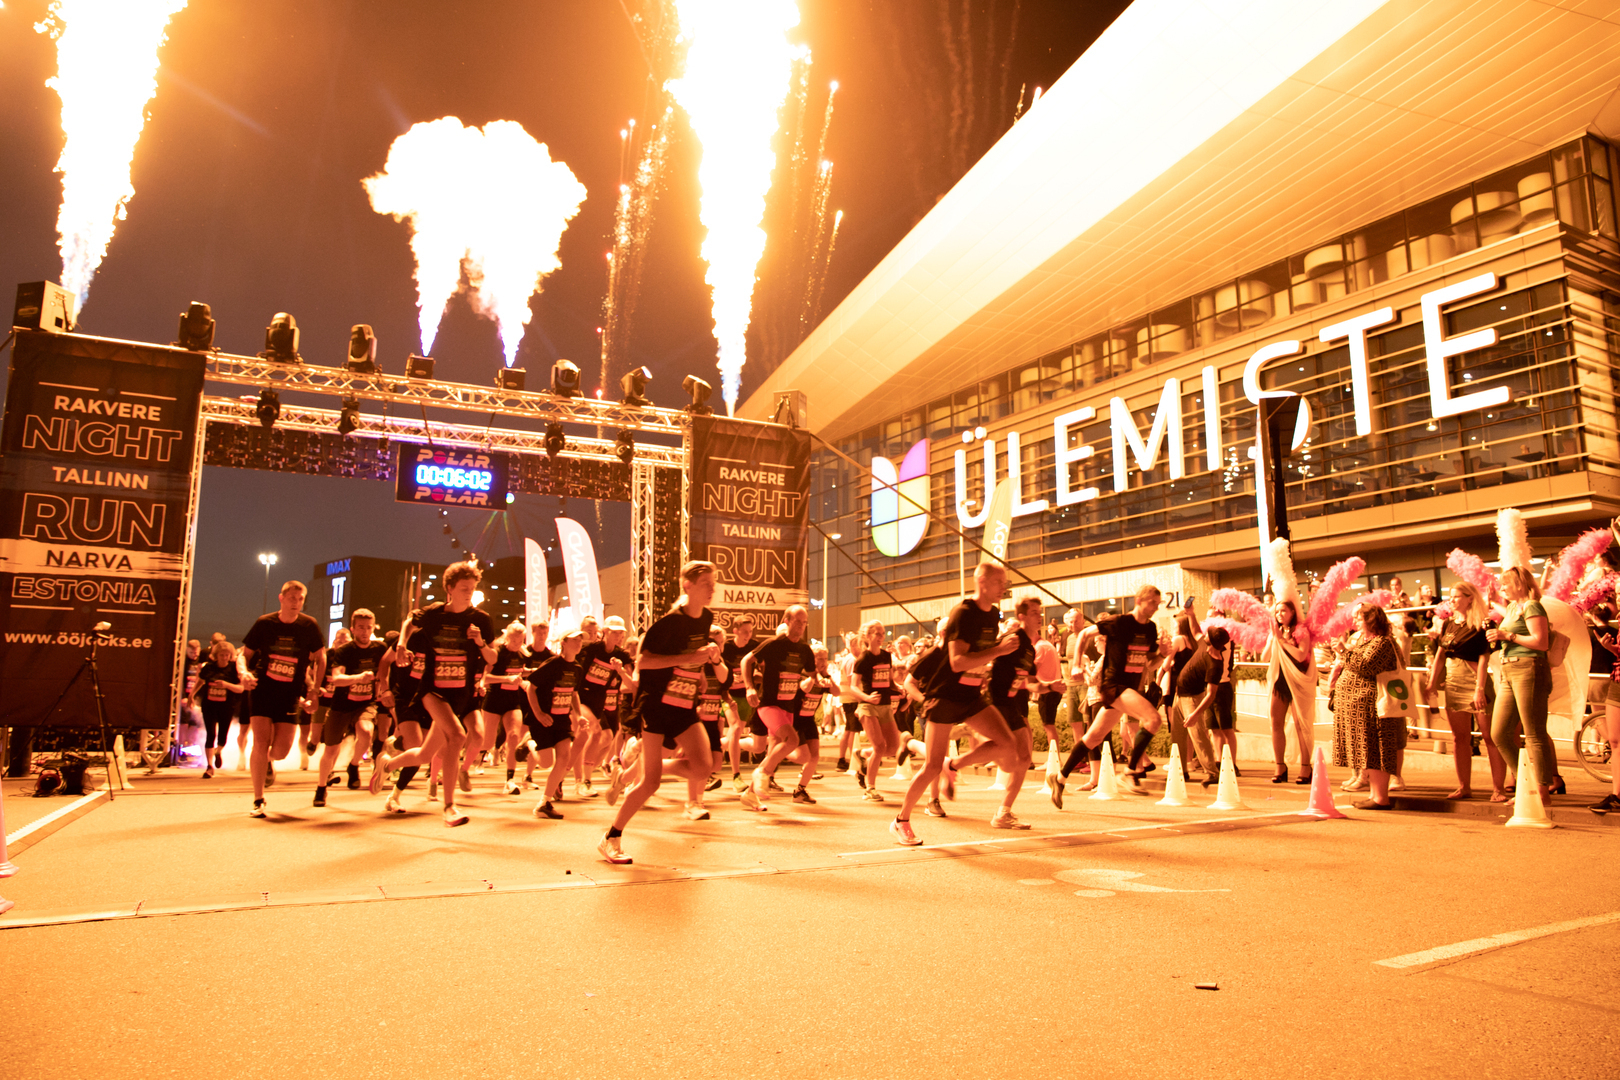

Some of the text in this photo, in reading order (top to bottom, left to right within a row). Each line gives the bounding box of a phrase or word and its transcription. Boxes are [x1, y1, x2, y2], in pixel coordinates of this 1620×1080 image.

[53, 394, 162, 422] RAKVERE
[954, 271, 1512, 529] ÜLEMISTE
[22, 414, 183, 462] NIGHT
[416, 448, 491, 469] POLAR
[52, 466, 149, 490] TALLINN
[415, 463, 492, 491] 00:06:02
[719, 466, 786, 486] RAKVERE
[413, 486, 489, 506] POLAR
[702, 482, 801, 518] NIGHT
[19, 492, 167, 547] RUN
[721, 523, 781, 541] TALLINN
[45, 549, 133, 571] NARVA
[326, 558, 352, 577] IMAX
[707, 544, 796, 586] RUN
[11, 575, 157, 606] ESTONIA
[723, 589, 776, 605] NARVA
[1165, 591, 1180, 609] 21
[436, 666, 466, 676] 2328
[351, 684, 373, 693] 2015
[667, 680, 697, 697] 2329
